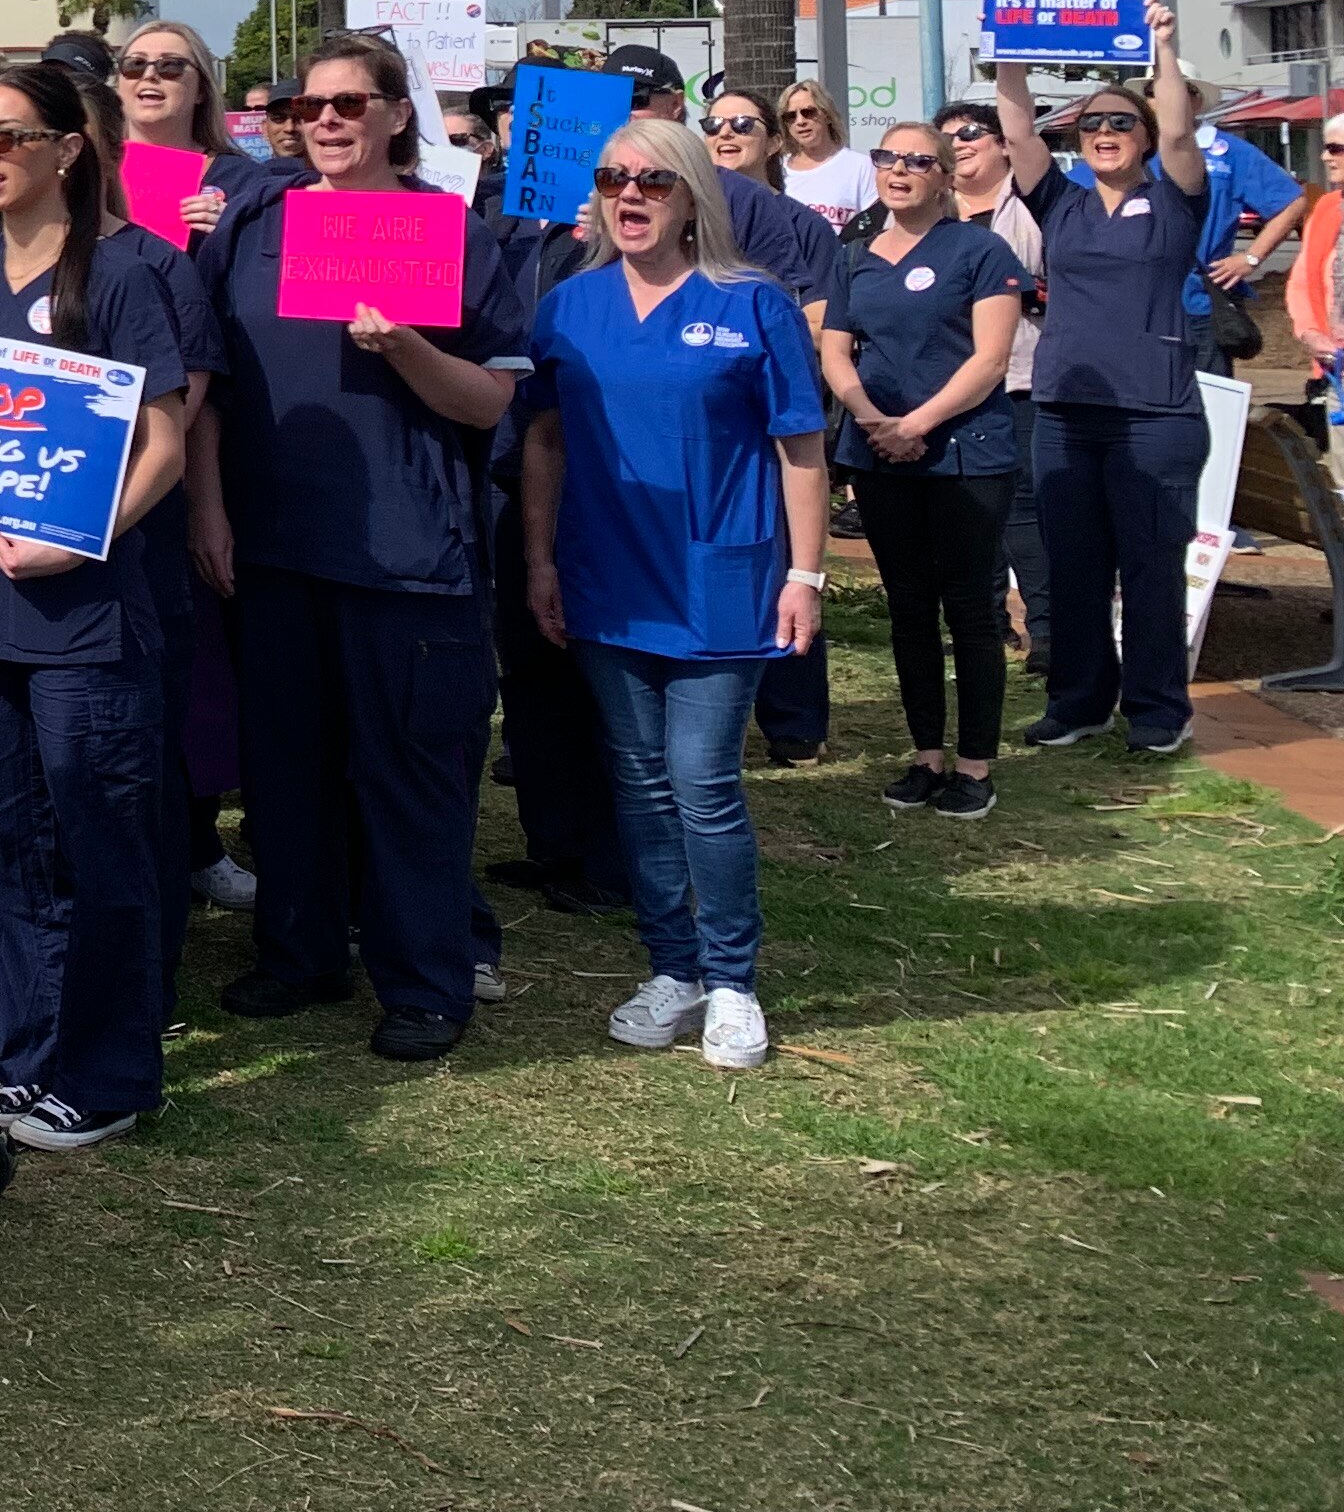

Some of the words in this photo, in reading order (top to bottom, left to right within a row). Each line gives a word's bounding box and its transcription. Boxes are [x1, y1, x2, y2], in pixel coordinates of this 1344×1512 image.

[995, 9, 1033, 25] LIFE
[1037, 10, 1056, 25] or
[1058, 10, 1119, 26] DEATH
[427, 30, 476, 50] Patient
[861, 112, 897, 129] shop
[523, 129, 594, 168] Being
[287, 256, 457, 286] EXHAUSTED
[12, 349, 40, 365] LIFE
[44, 356, 56, 368] or
[59, 358, 102, 379] DEATH
[37, 446, 86, 473] US
